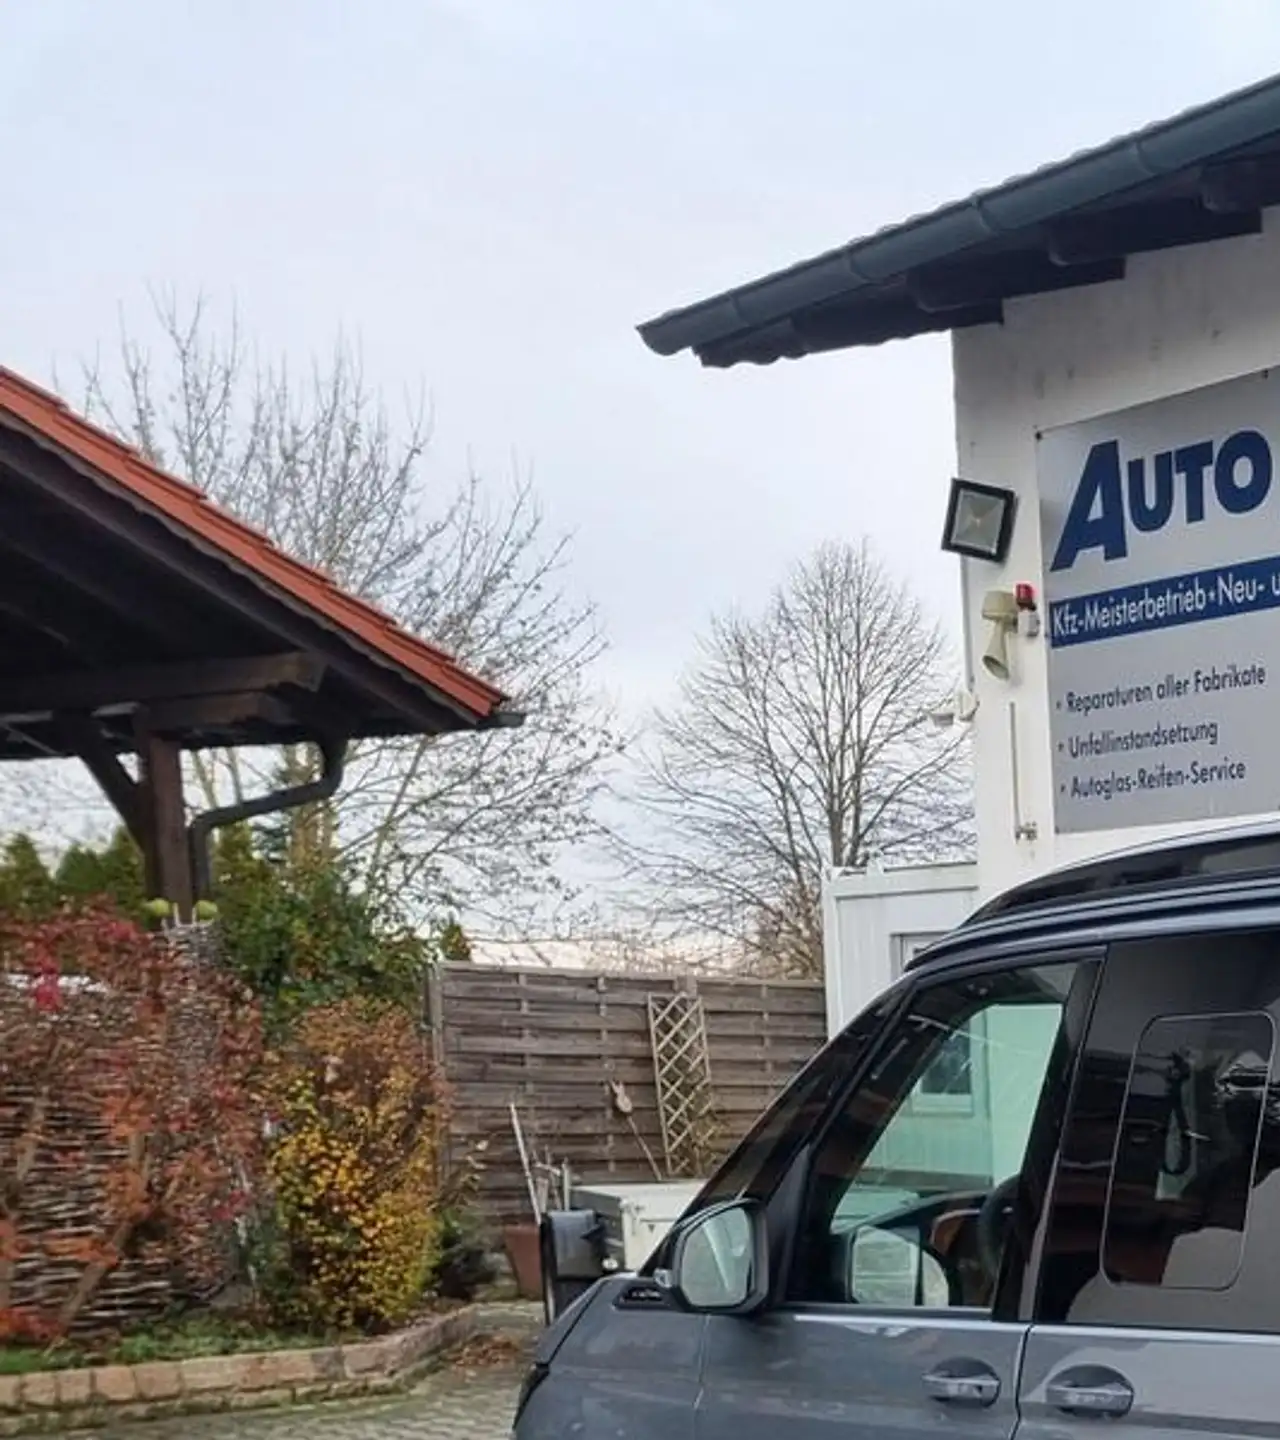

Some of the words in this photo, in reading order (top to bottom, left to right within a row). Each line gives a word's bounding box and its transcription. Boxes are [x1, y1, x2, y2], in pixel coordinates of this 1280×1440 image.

[1050, 430, 1273, 572] AUTO
[1066, 684, 1152, 716] Reparaturen
[1157, 674, 1190, 698] aller
[1194, 664, 1266, 692] Fabrikate
[1068, 721, 1218, 758] Unfallinstandsetzung
[1071, 756, 1246, 800] Autoglas-Reifen-Service
